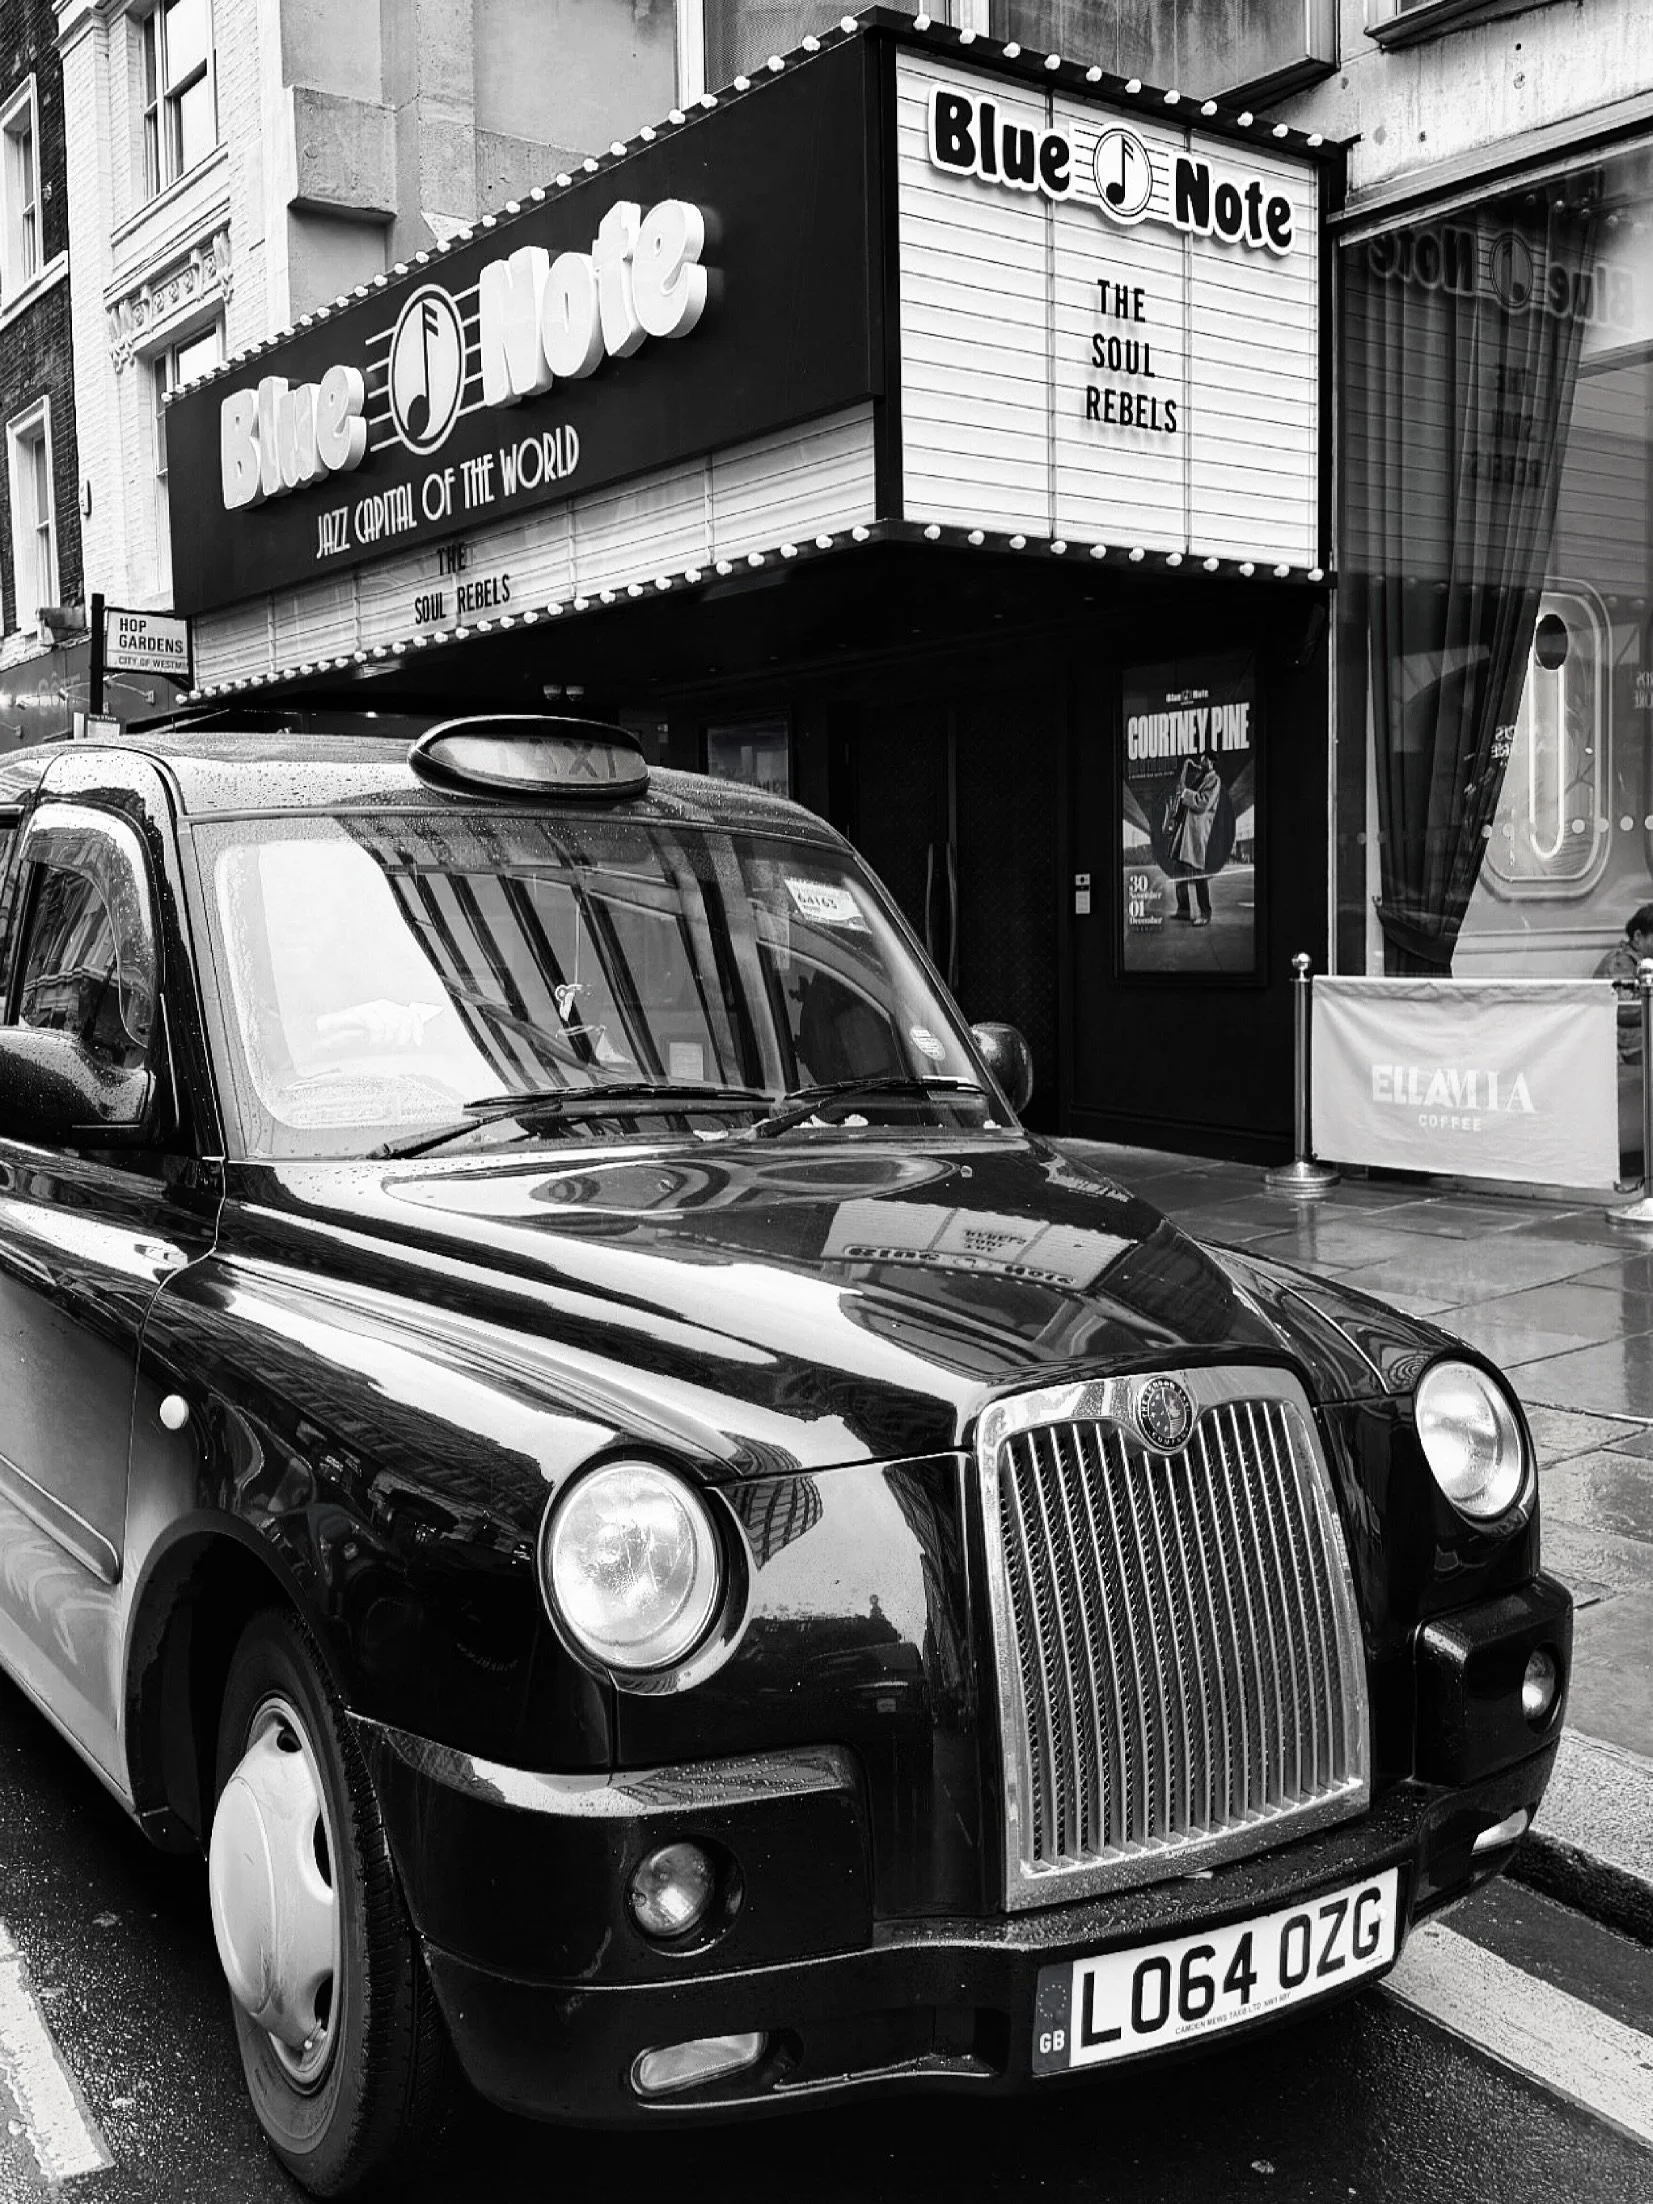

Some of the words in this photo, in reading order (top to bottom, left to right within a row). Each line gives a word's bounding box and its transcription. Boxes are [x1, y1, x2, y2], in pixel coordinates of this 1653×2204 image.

[933, 91, 1070, 193] Blue
[1174, 156, 1293, 248] Note
[1097, 279, 1147, 323] THE
[221, 364, 367, 511] Blue
[478, 198, 708, 407] Note
[1091, 333, 1155, 377] SOUL
[1086, 385, 1177, 433] REBELS
[316, 506, 351, 559] JAZZ
[354, 482, 417, 544] CAPITAL
[421, 467, 456, 521] OF
[460, 453, 495, 509] THE
[499, 424, 580, 497] WORLD
[436, 541, 466, 576] THE
[414, 591, 447, 625] SOUL
[456, 573, 510, 614] REBELS
[118, 635, 184, 654] GARDENS
[119, 617, 147, 633] HOP
[118, 655, 138, 665] CITY
[139, 657, 150, 667] OF
[1128, 707, 1209, 761] COURTNEY
[1211, 701, 1250, 752] PINE
[1128, 874, 1149, 893] 30
[1128, 900, 1145, 917] 01
[1371, 1063, 1537, 1114] ELLAMIA
[1418, 1113, 1482, 1132] COFFEE
[1080, 1931, 1258, 2049] LO64
[1279, 1886, 1383, 1990] OZG
[1039, 2030, 1065, 2054] GB
